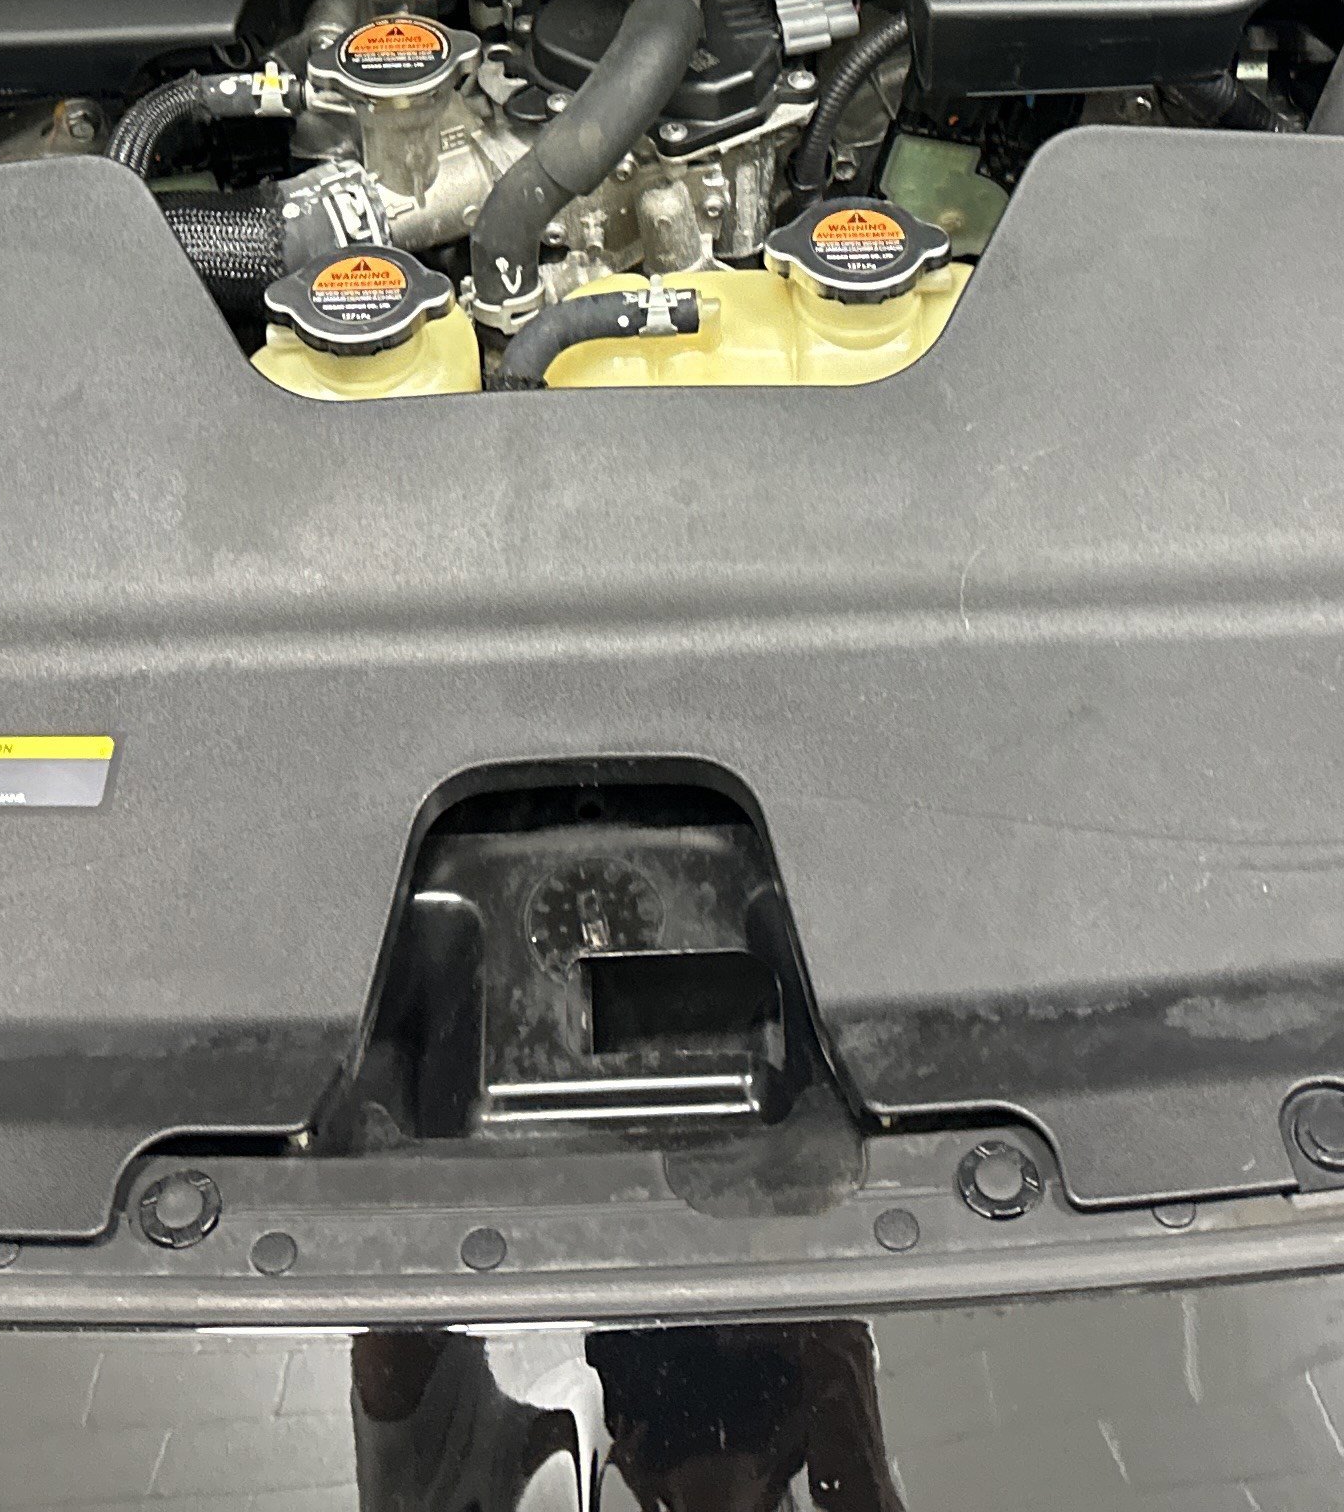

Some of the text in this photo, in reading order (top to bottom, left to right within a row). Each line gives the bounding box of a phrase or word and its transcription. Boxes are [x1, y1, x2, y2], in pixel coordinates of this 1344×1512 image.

[367, 36, 422, 44] WARNING
[827, 223, 887, 231] WARNING
[331, 271, 390, 280] WARNING
